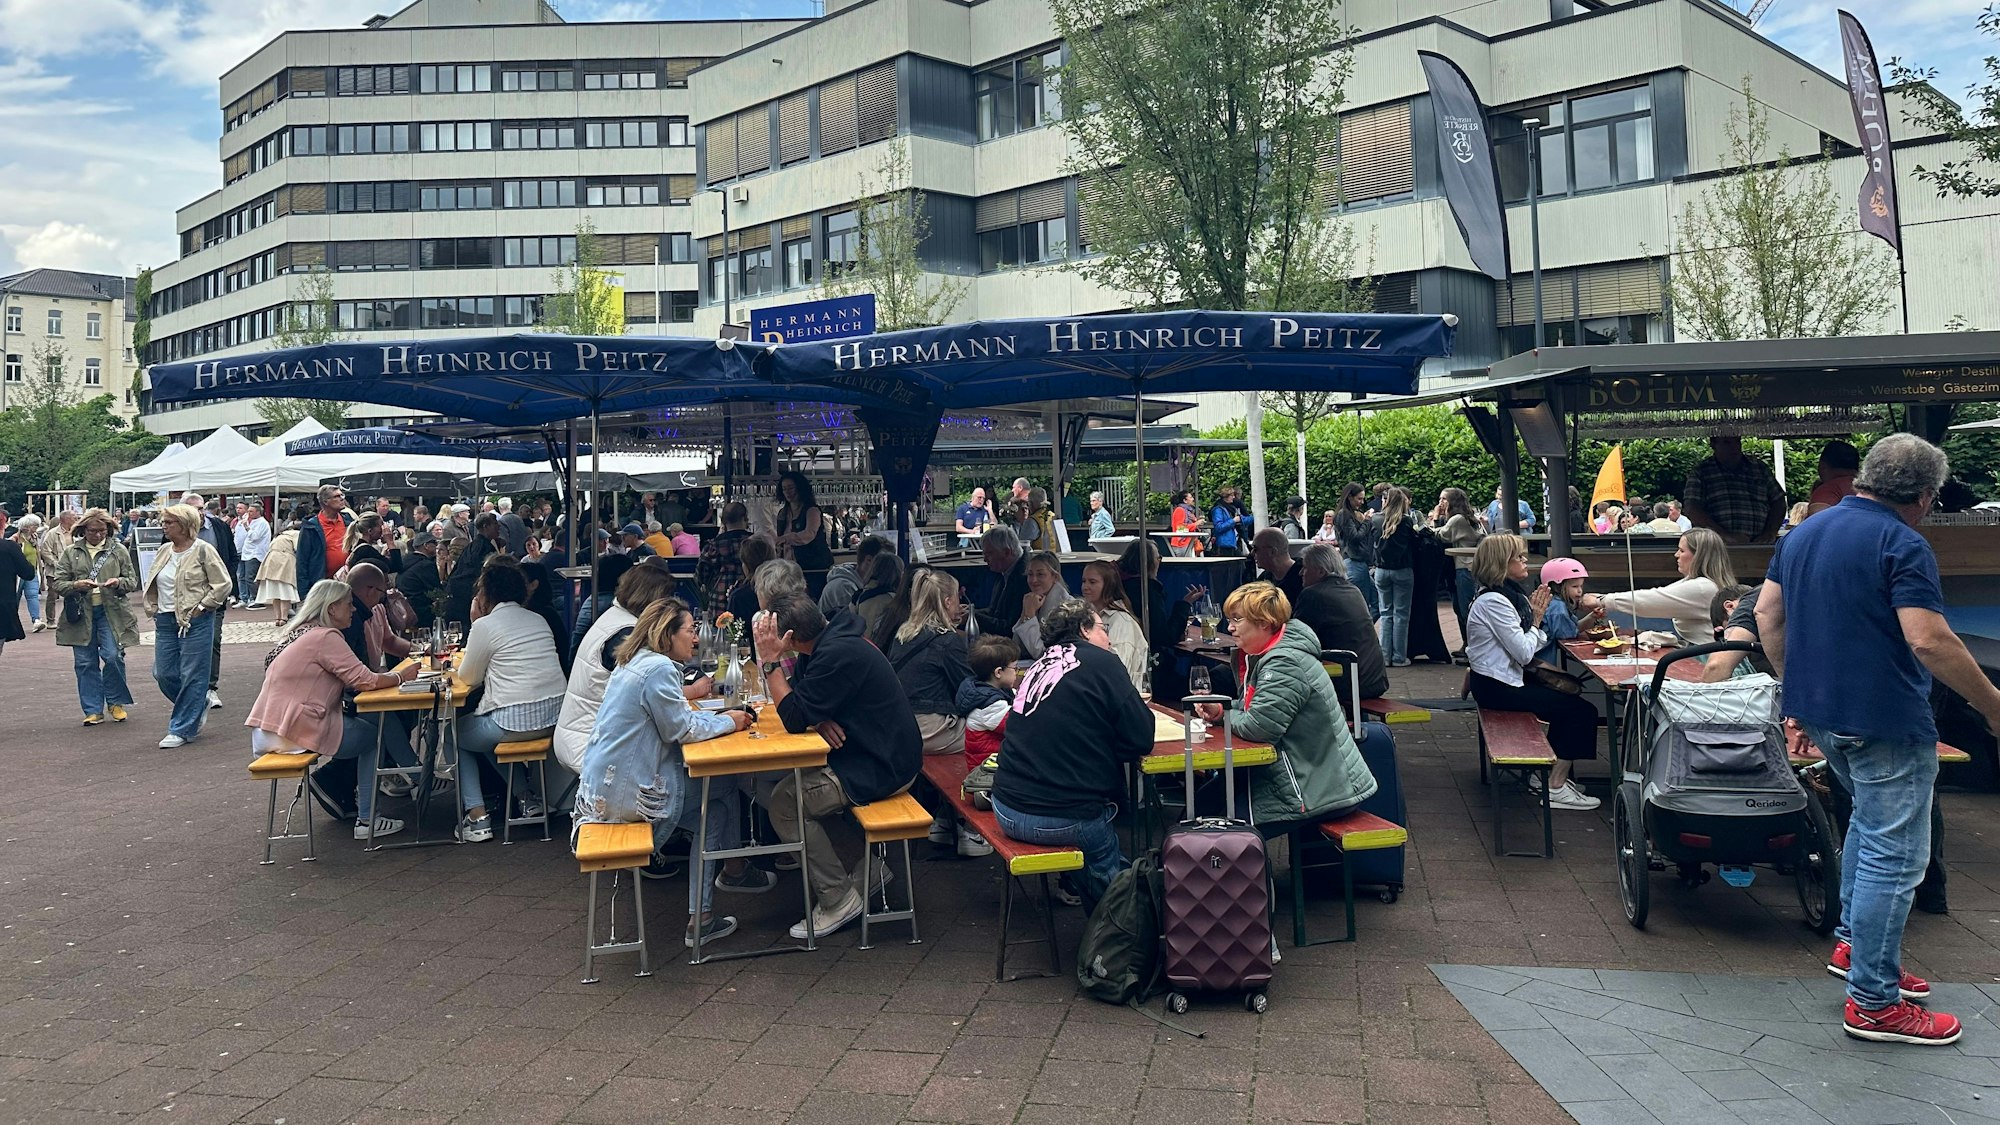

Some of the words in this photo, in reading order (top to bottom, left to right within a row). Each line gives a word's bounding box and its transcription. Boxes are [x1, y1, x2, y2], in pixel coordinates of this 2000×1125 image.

[760, 307, 862, 329] HERMANN
[786, 321, 862, 339] HEINRICH
[832, 335, 1017, 372] HERMANN
[1045, 321, 1244, 353] HEINRICH
[1269, 318, 1382, 350] PEITZ
[193, 356, 355, 390] HERMANN
[379, 346, 552, 375] HEINRICH
[573, 342, 668, 373] PEITZ
[1902, 367, 1954, 380] Weingut
[1872, 383, 1936, 395] Weinstube
[291, 437, 328, 451] HERMANN
[332, 432, 371, 446] HEINRICH
[374, 431, 397, 445] PEITZ
[880, 432, 929, 447] PEITZ
[1091, 448, 1136, 457] Piesport/Mose
[1745, 798, 1787, 808] Qeridoo
